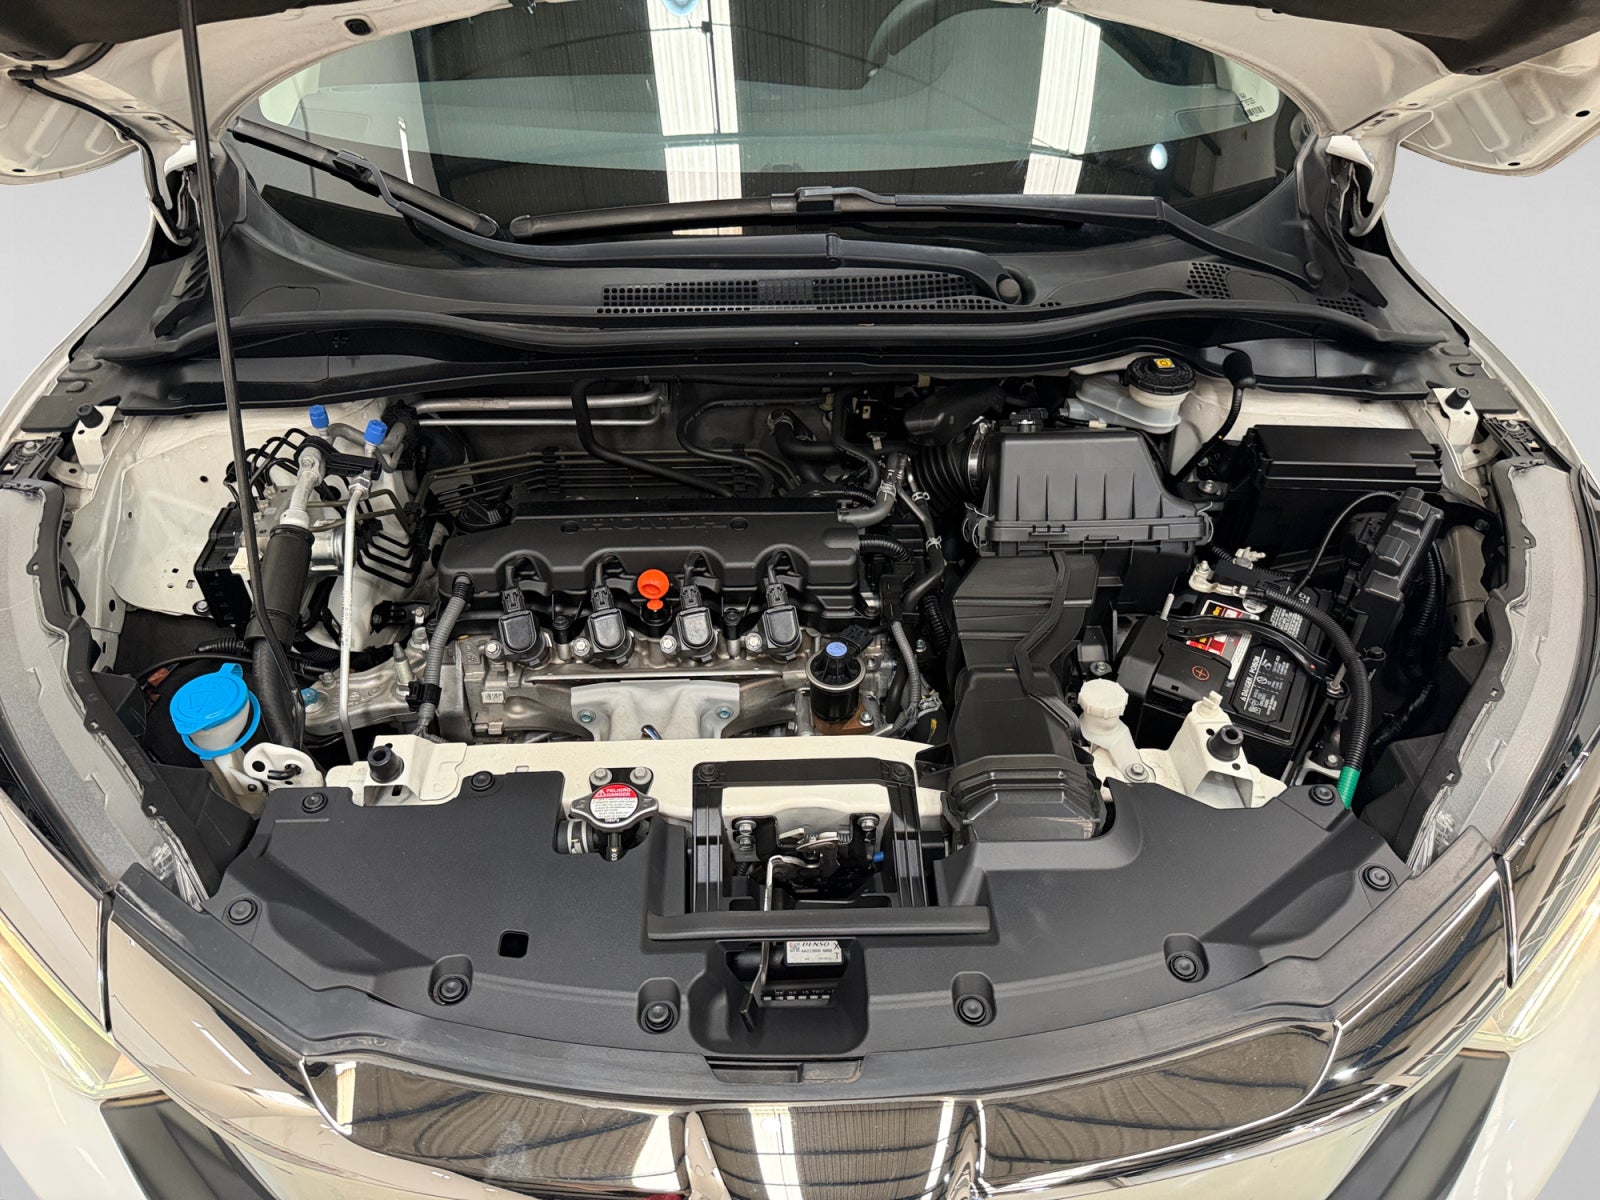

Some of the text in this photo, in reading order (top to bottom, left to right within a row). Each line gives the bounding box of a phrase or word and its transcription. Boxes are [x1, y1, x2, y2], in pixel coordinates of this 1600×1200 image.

[581, 517, 728, 531] HONDA
[1241, 676, 1253, 697] DANGER
[1248, 655, 1261, 674] POISON
